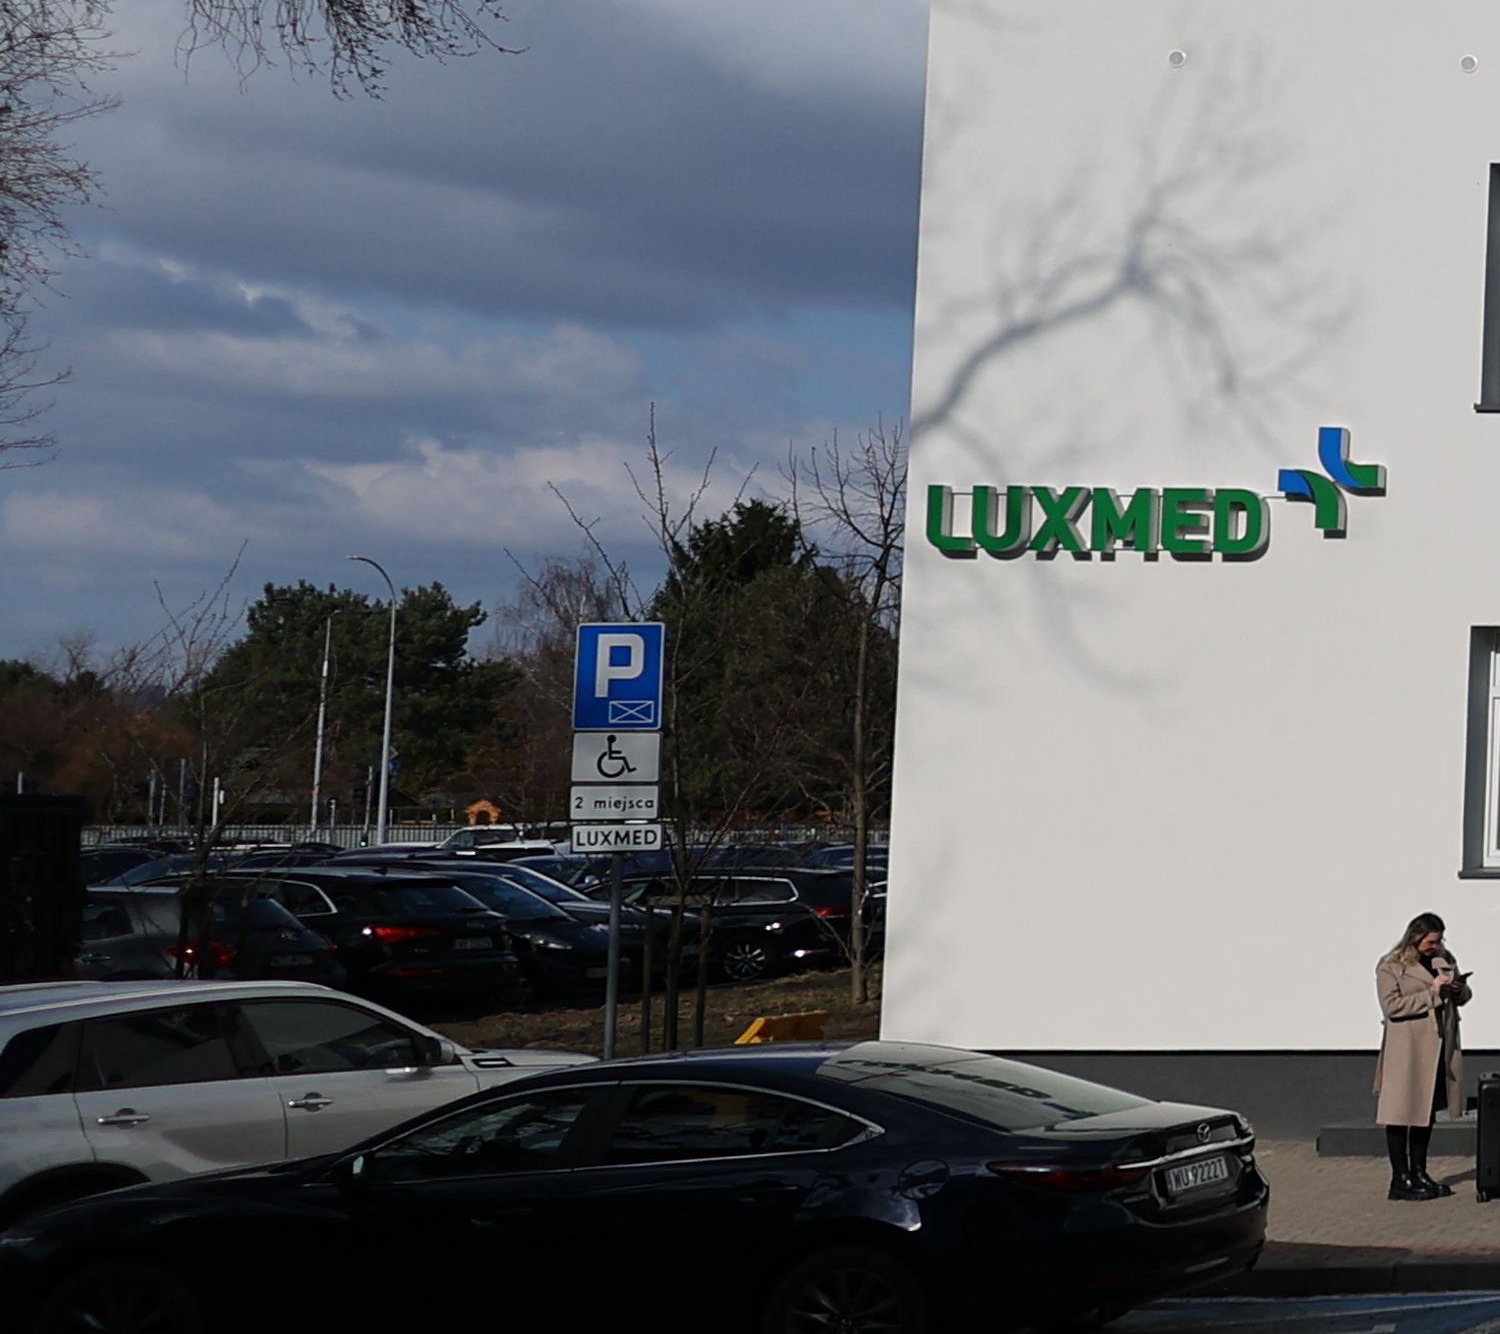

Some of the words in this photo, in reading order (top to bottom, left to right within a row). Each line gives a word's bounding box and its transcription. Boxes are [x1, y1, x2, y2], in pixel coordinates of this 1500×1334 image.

[926, 484, 1268, 556] LUXMED
[594, 633, 645, 698] P
[575, 797, 584, 809] 2
[594, 796, 655, 813] miejsca
[576, 830, 658, 847] LUXMED
[1172, 1168, 1190, 1188] WU
[1191, 1158, 1225, 1184] 9222T
